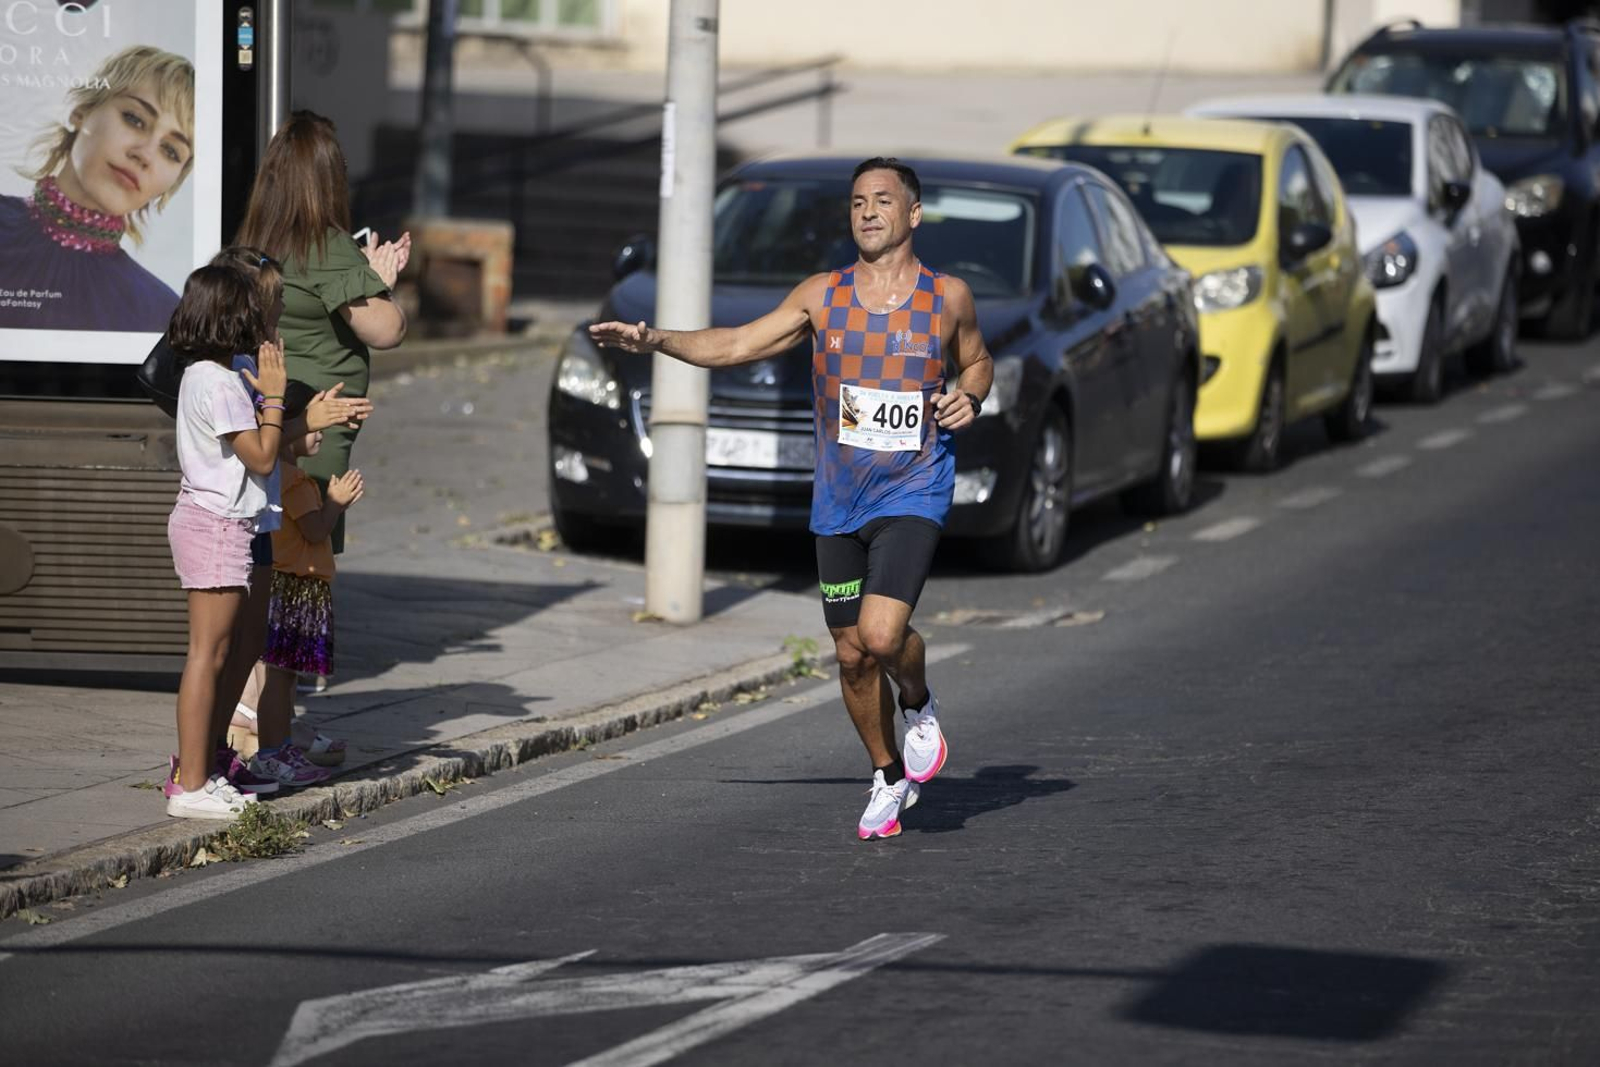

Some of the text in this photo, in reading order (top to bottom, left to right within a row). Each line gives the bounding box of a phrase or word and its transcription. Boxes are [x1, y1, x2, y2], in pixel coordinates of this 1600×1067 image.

[16, 75, 111, 90] MAGNOLIA
[16, 289, 28, 298] de
[30, 289, 62, 298] Parfum
[872, 402, 919, 430] 406
